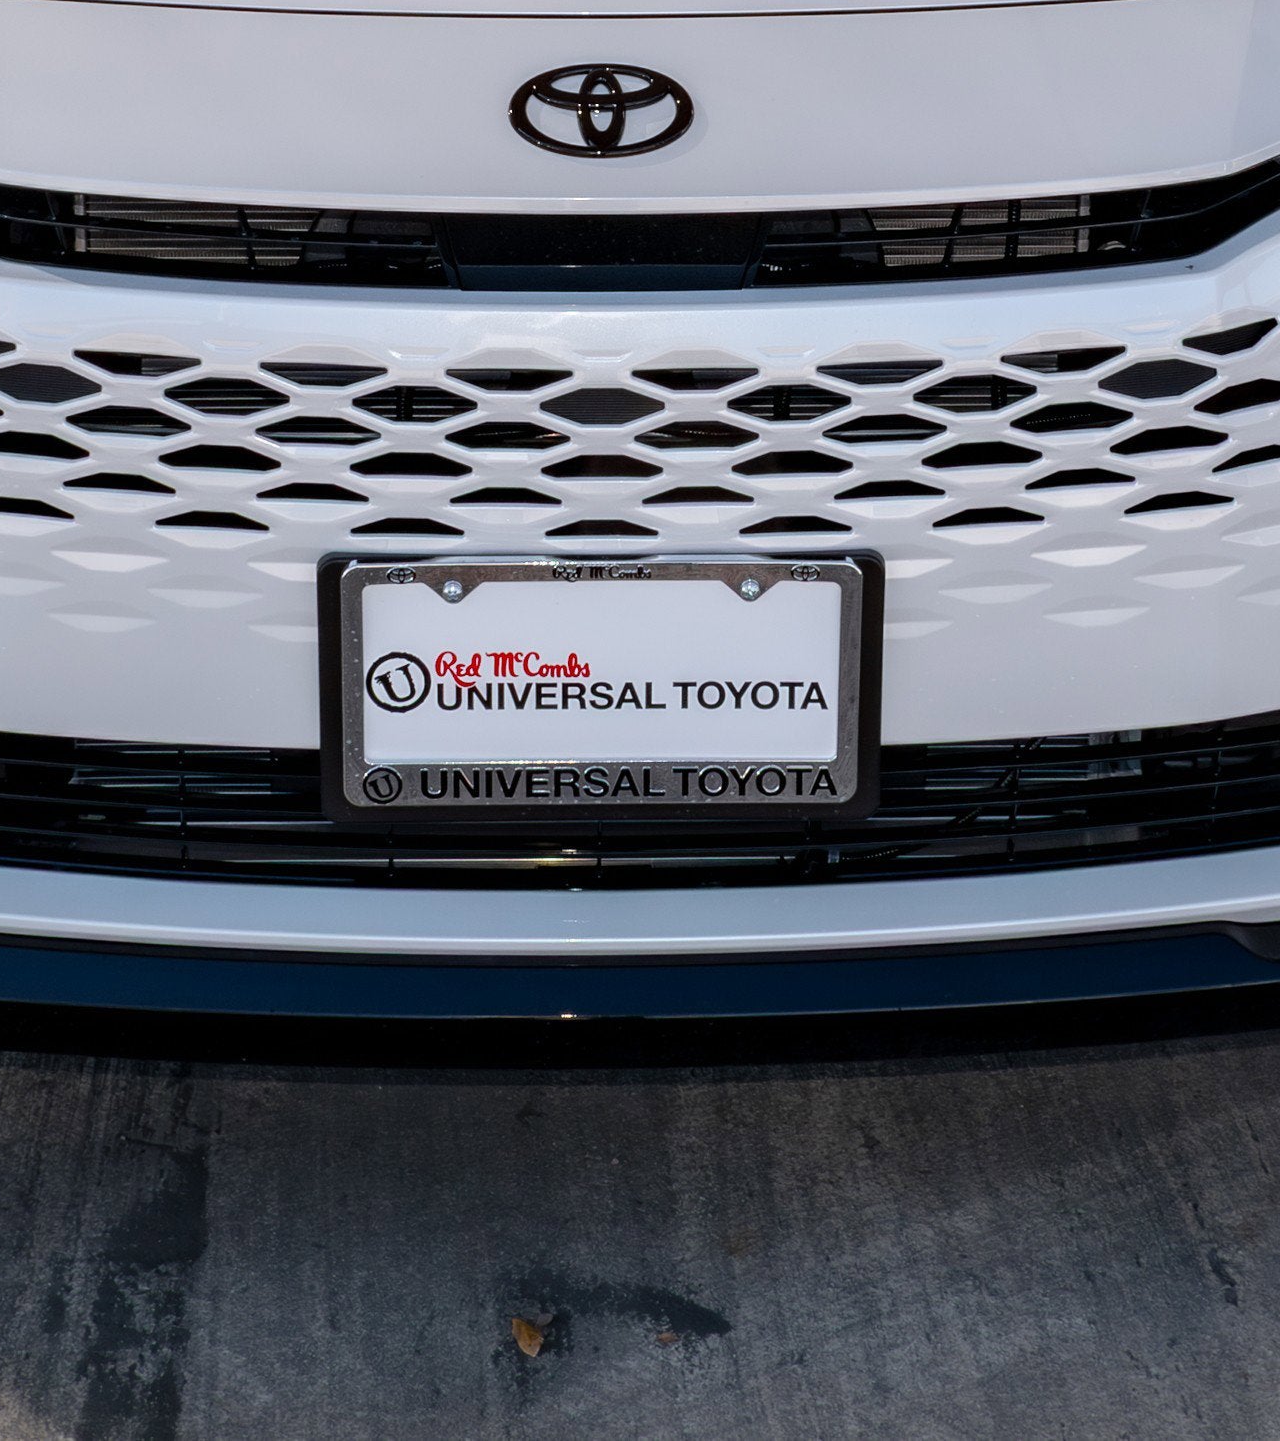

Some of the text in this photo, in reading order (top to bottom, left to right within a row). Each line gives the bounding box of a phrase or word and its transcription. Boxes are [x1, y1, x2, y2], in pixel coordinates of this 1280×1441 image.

[552, 564, 583, 582] Red
[434, 650, 591, 688] Red McCombs
[437, 681, 666, 711] UNIVERSAL
[673, 680, 828, 710] TOYOTA
[420, 766, 666, 800] UNIVERSAL
[673, 765, 838, 797] TOYOTA
